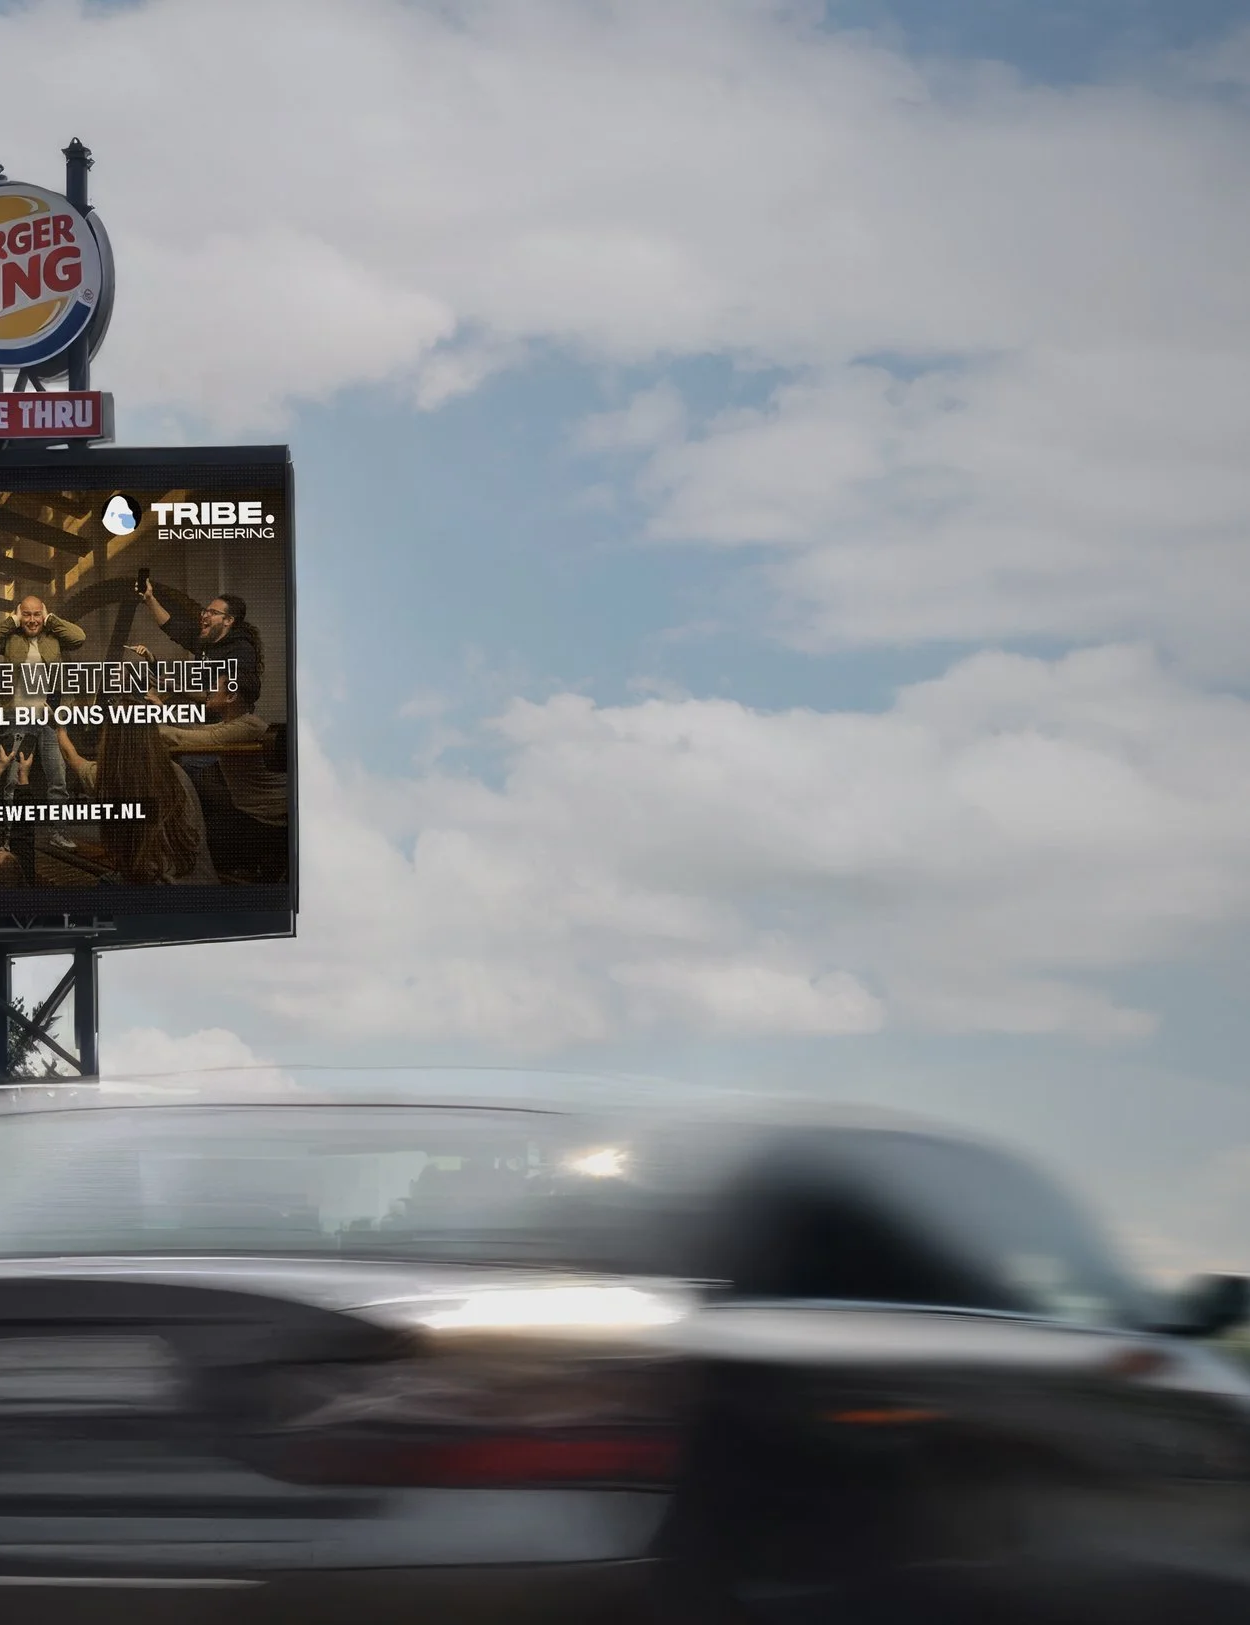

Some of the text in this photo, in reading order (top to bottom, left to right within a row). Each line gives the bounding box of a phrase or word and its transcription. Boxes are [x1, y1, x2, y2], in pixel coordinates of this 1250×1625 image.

[19, 400, 93, 428] THRU
[151, 501, 275, 525] TRIBE.
[158, 528, 275, 540] ENGINEERING
[21, 661, 149, 695] WETEN
[157, 658, 239, 692] HET!
[15, 705, 49, 726] BIJ
[54, 705, 104, 726] ONS
[108, 703, 206, 724] WERKEN
